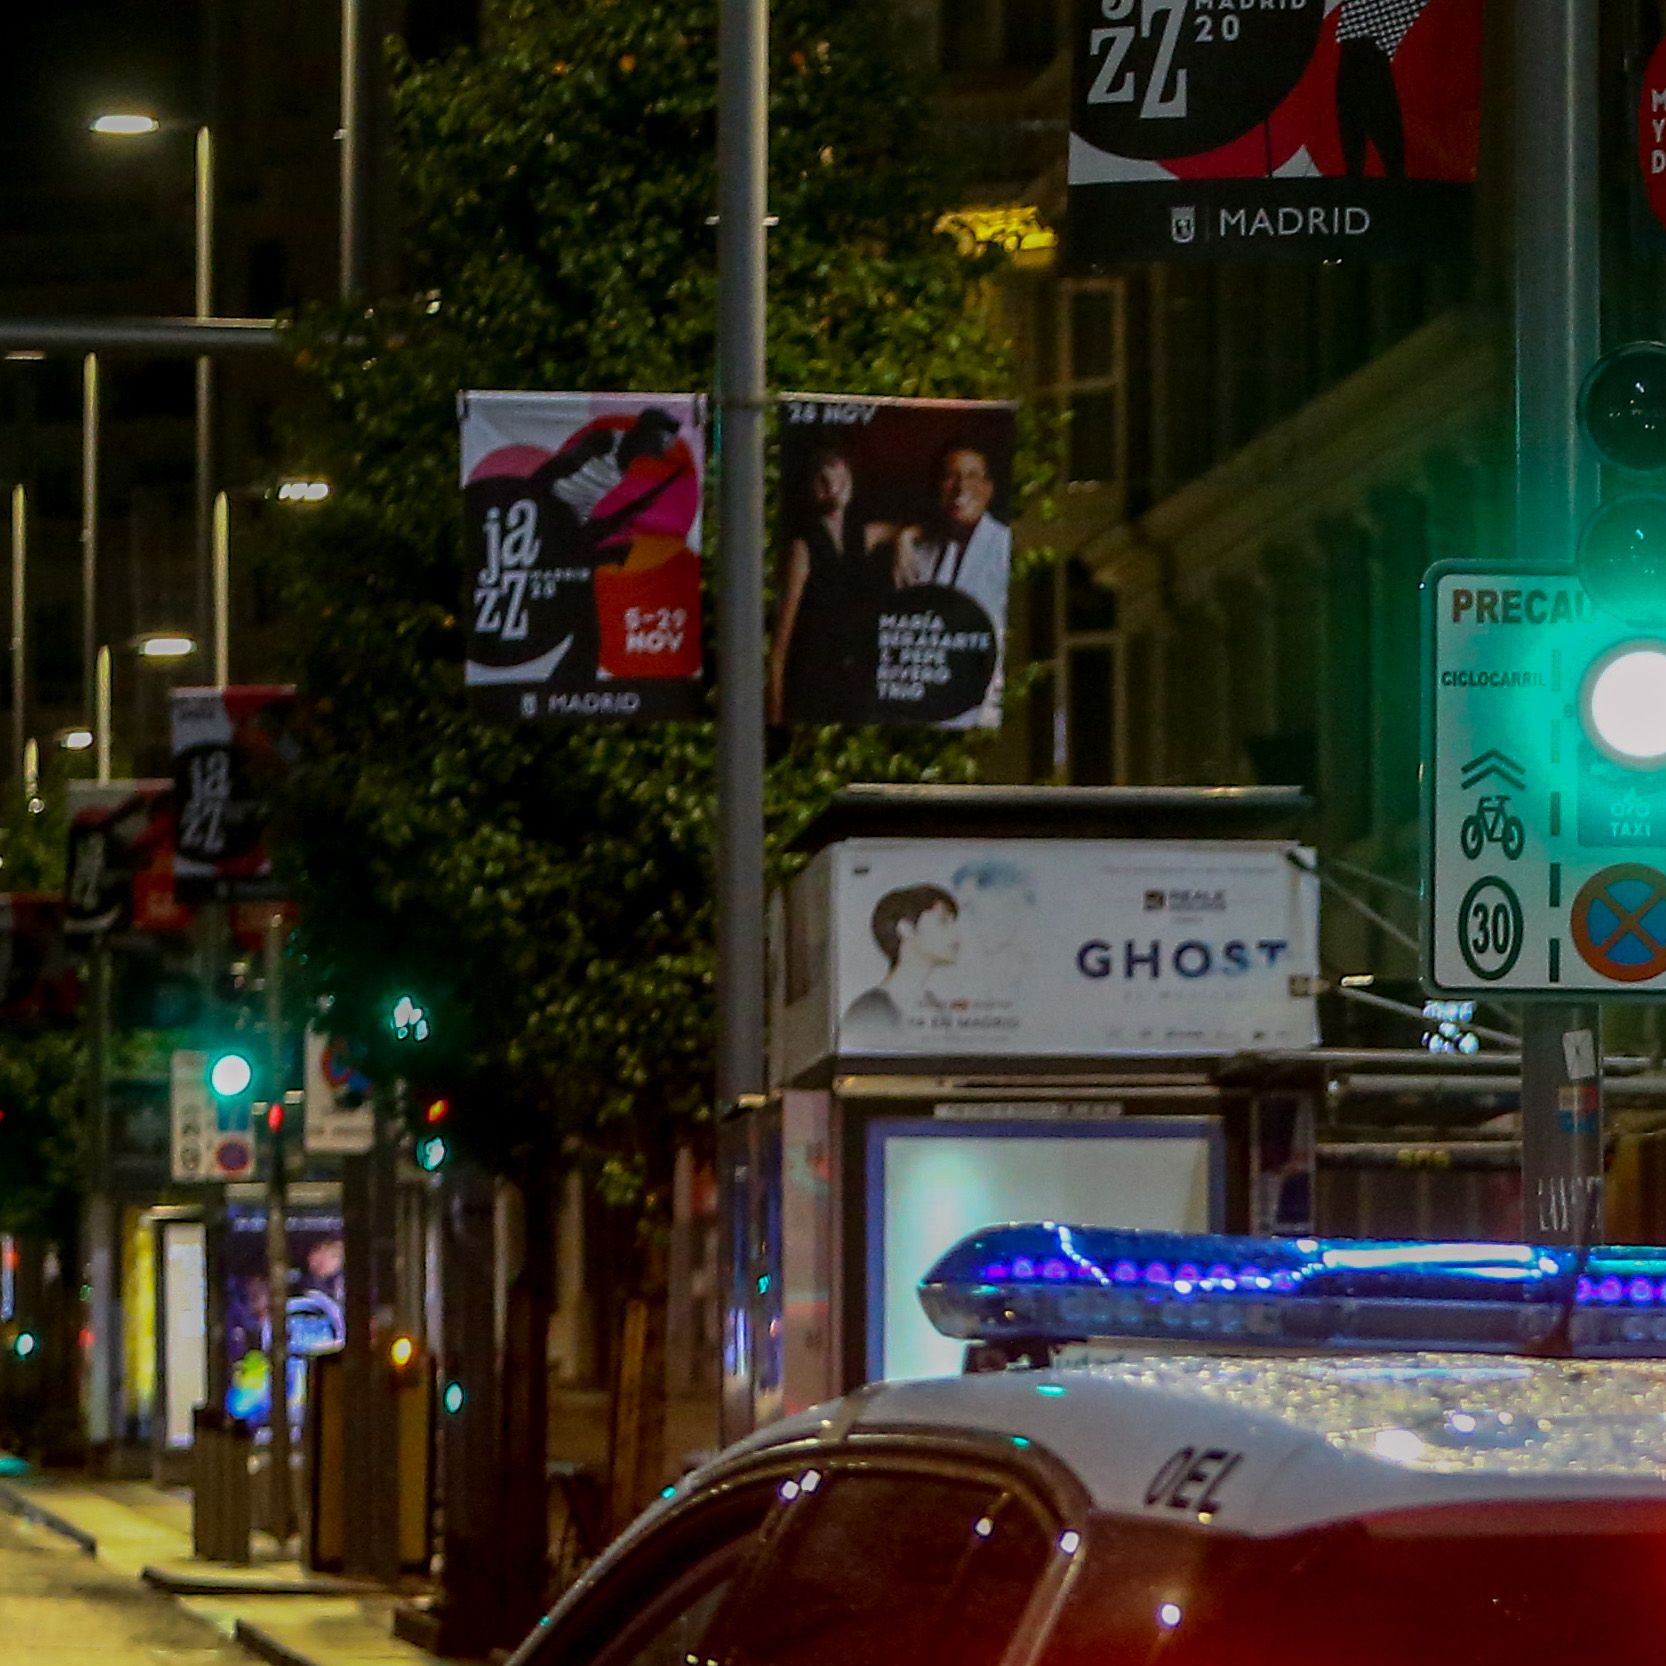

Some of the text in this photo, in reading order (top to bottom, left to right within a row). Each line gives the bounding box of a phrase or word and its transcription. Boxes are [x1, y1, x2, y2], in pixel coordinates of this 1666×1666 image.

[1194, 16, 1241, 43] 20
[1651, 118, 1666, 143] Y
[1219, 207, 1371, 238] MADRID
[625, 631, 684, 653] NOV
[1441, 670, 1546, 688] CICLOCARRIL
[548, 692, 641, 714] MADRID
[1611, 820, 1652, 839] TAXI
[1472, 902, 1509, 954] 30
[1076, 938, 1288, 982] GHOST
